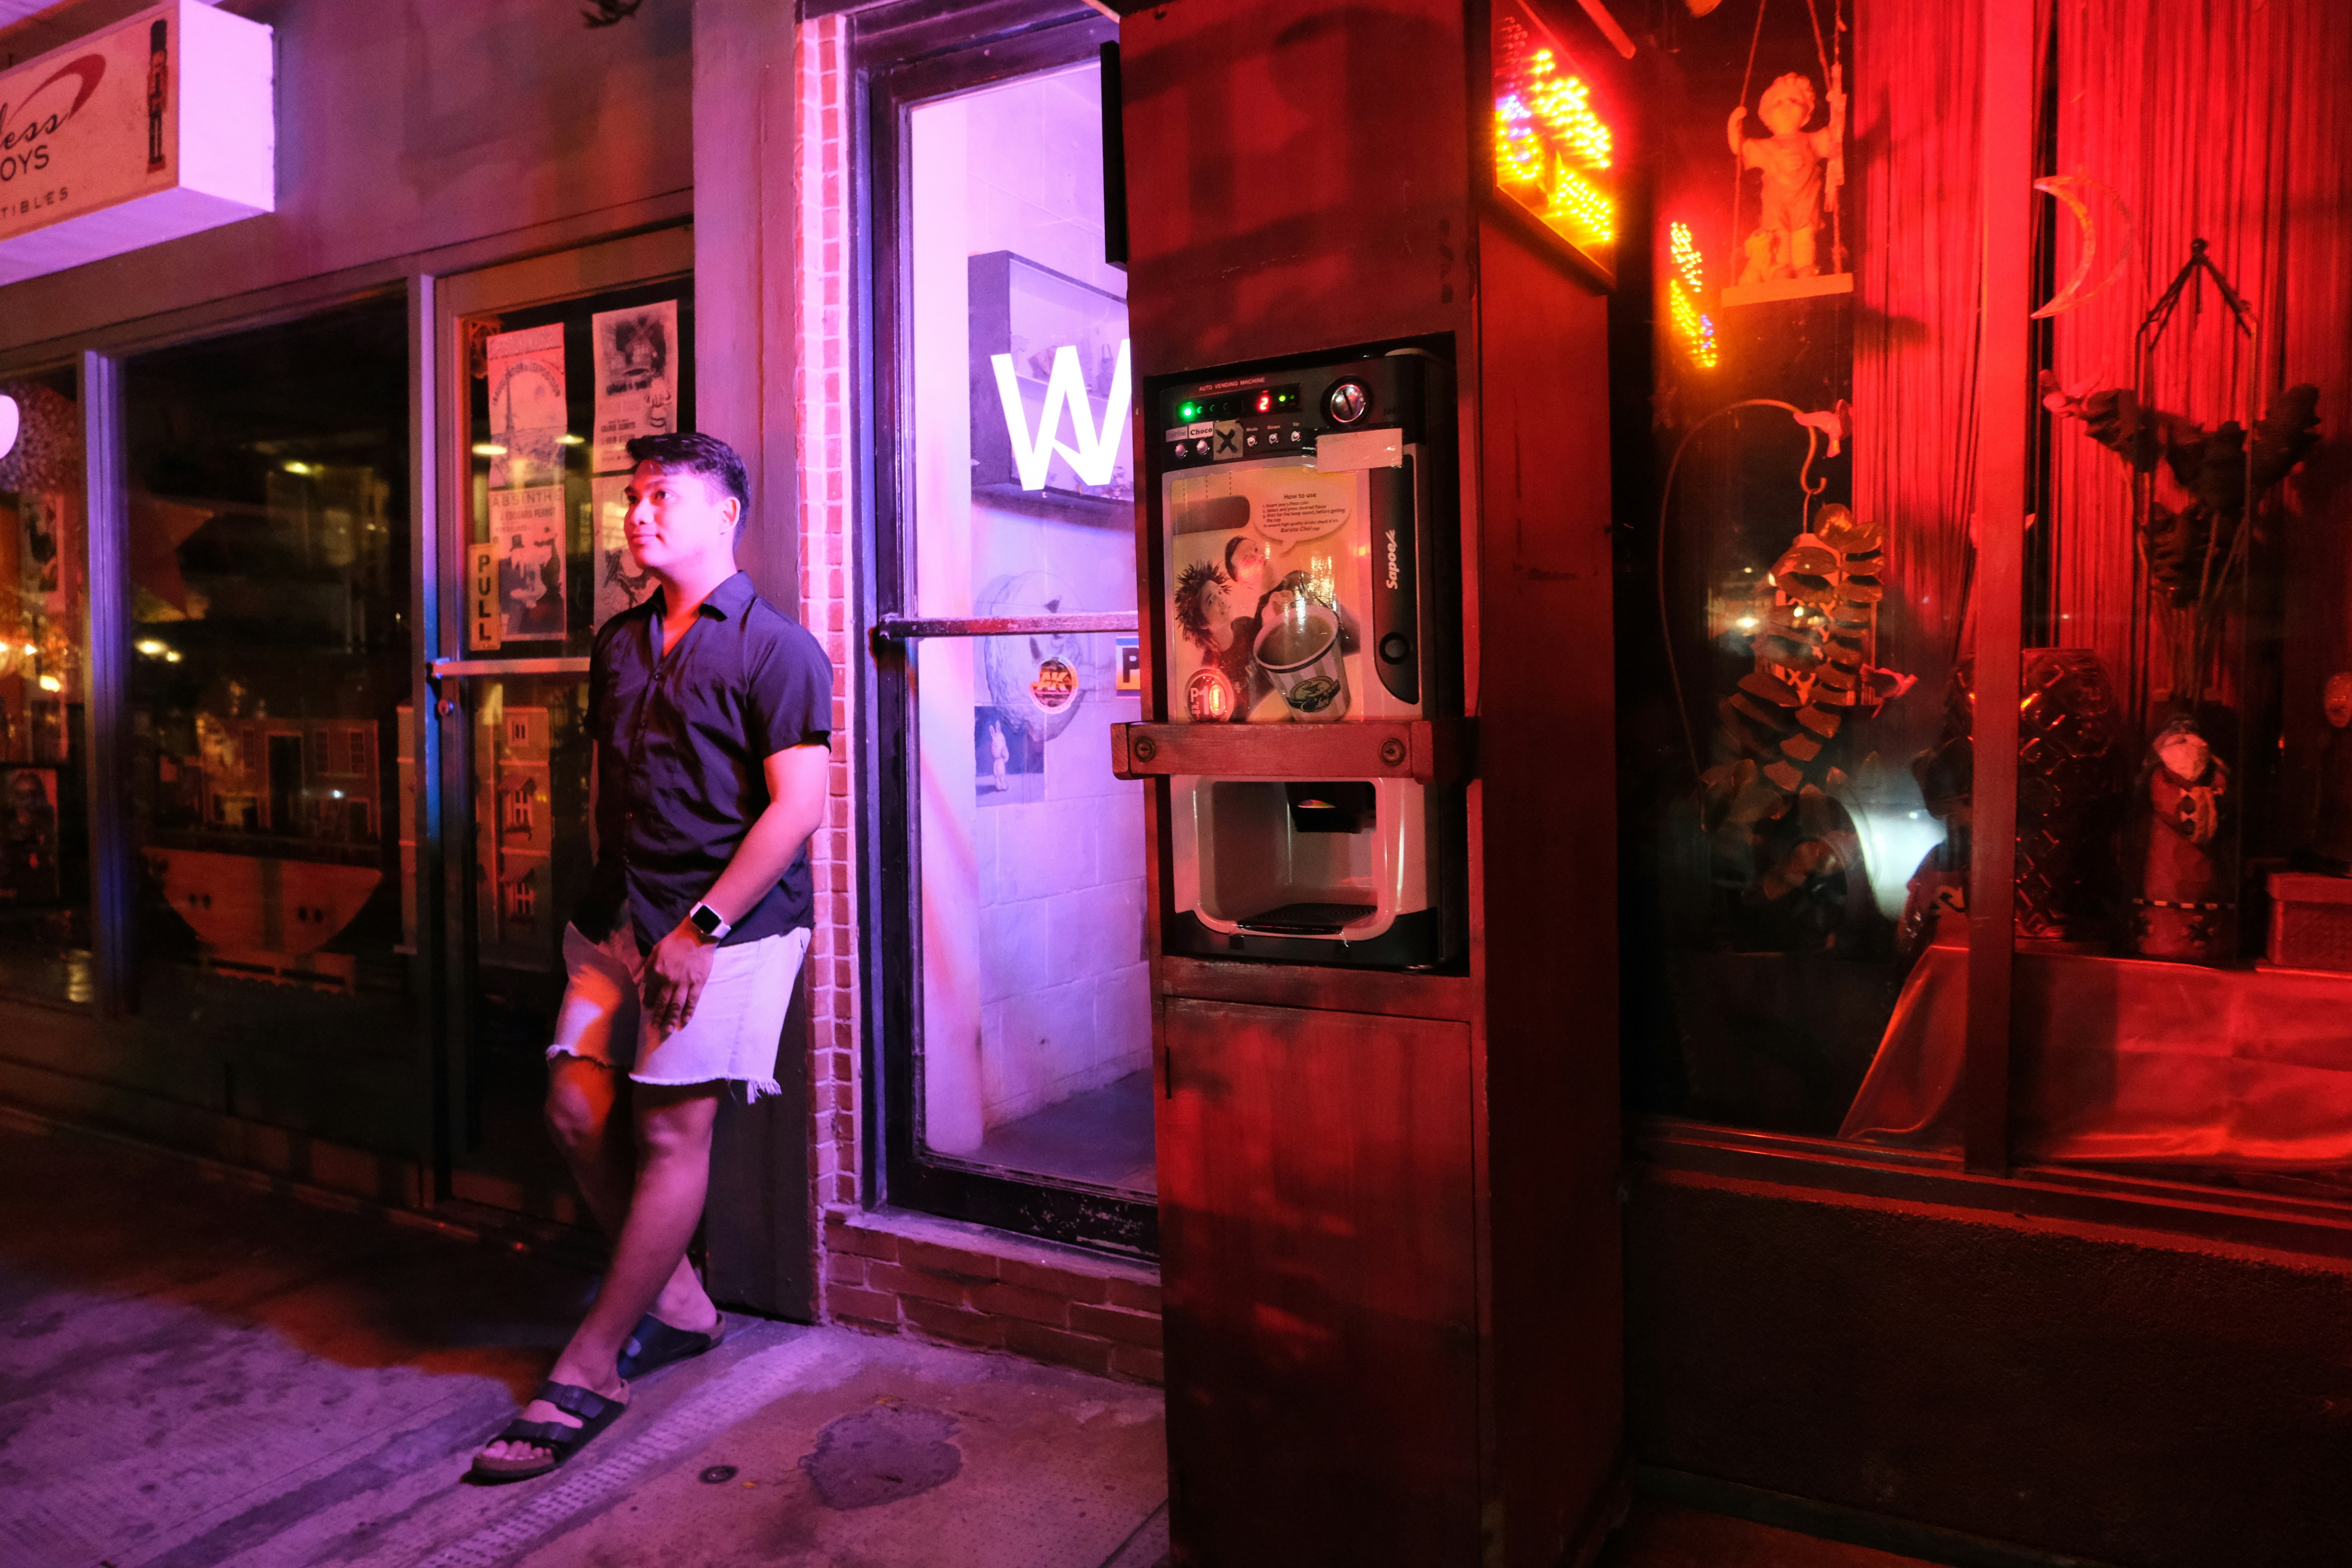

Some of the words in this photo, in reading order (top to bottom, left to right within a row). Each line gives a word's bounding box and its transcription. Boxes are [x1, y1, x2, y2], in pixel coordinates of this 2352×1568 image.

[0, 145, 49, 181] OYS
[1, 187, 68, 219] TIBLES
[1214, 380, 1238, 389] VENDING
[1260, 397, 1268, 410] 2
[1385, 530, 1400, 590] Sapoe
[478, 554, 492, 641] PULL
[1122, 647, 1140, 683] P
